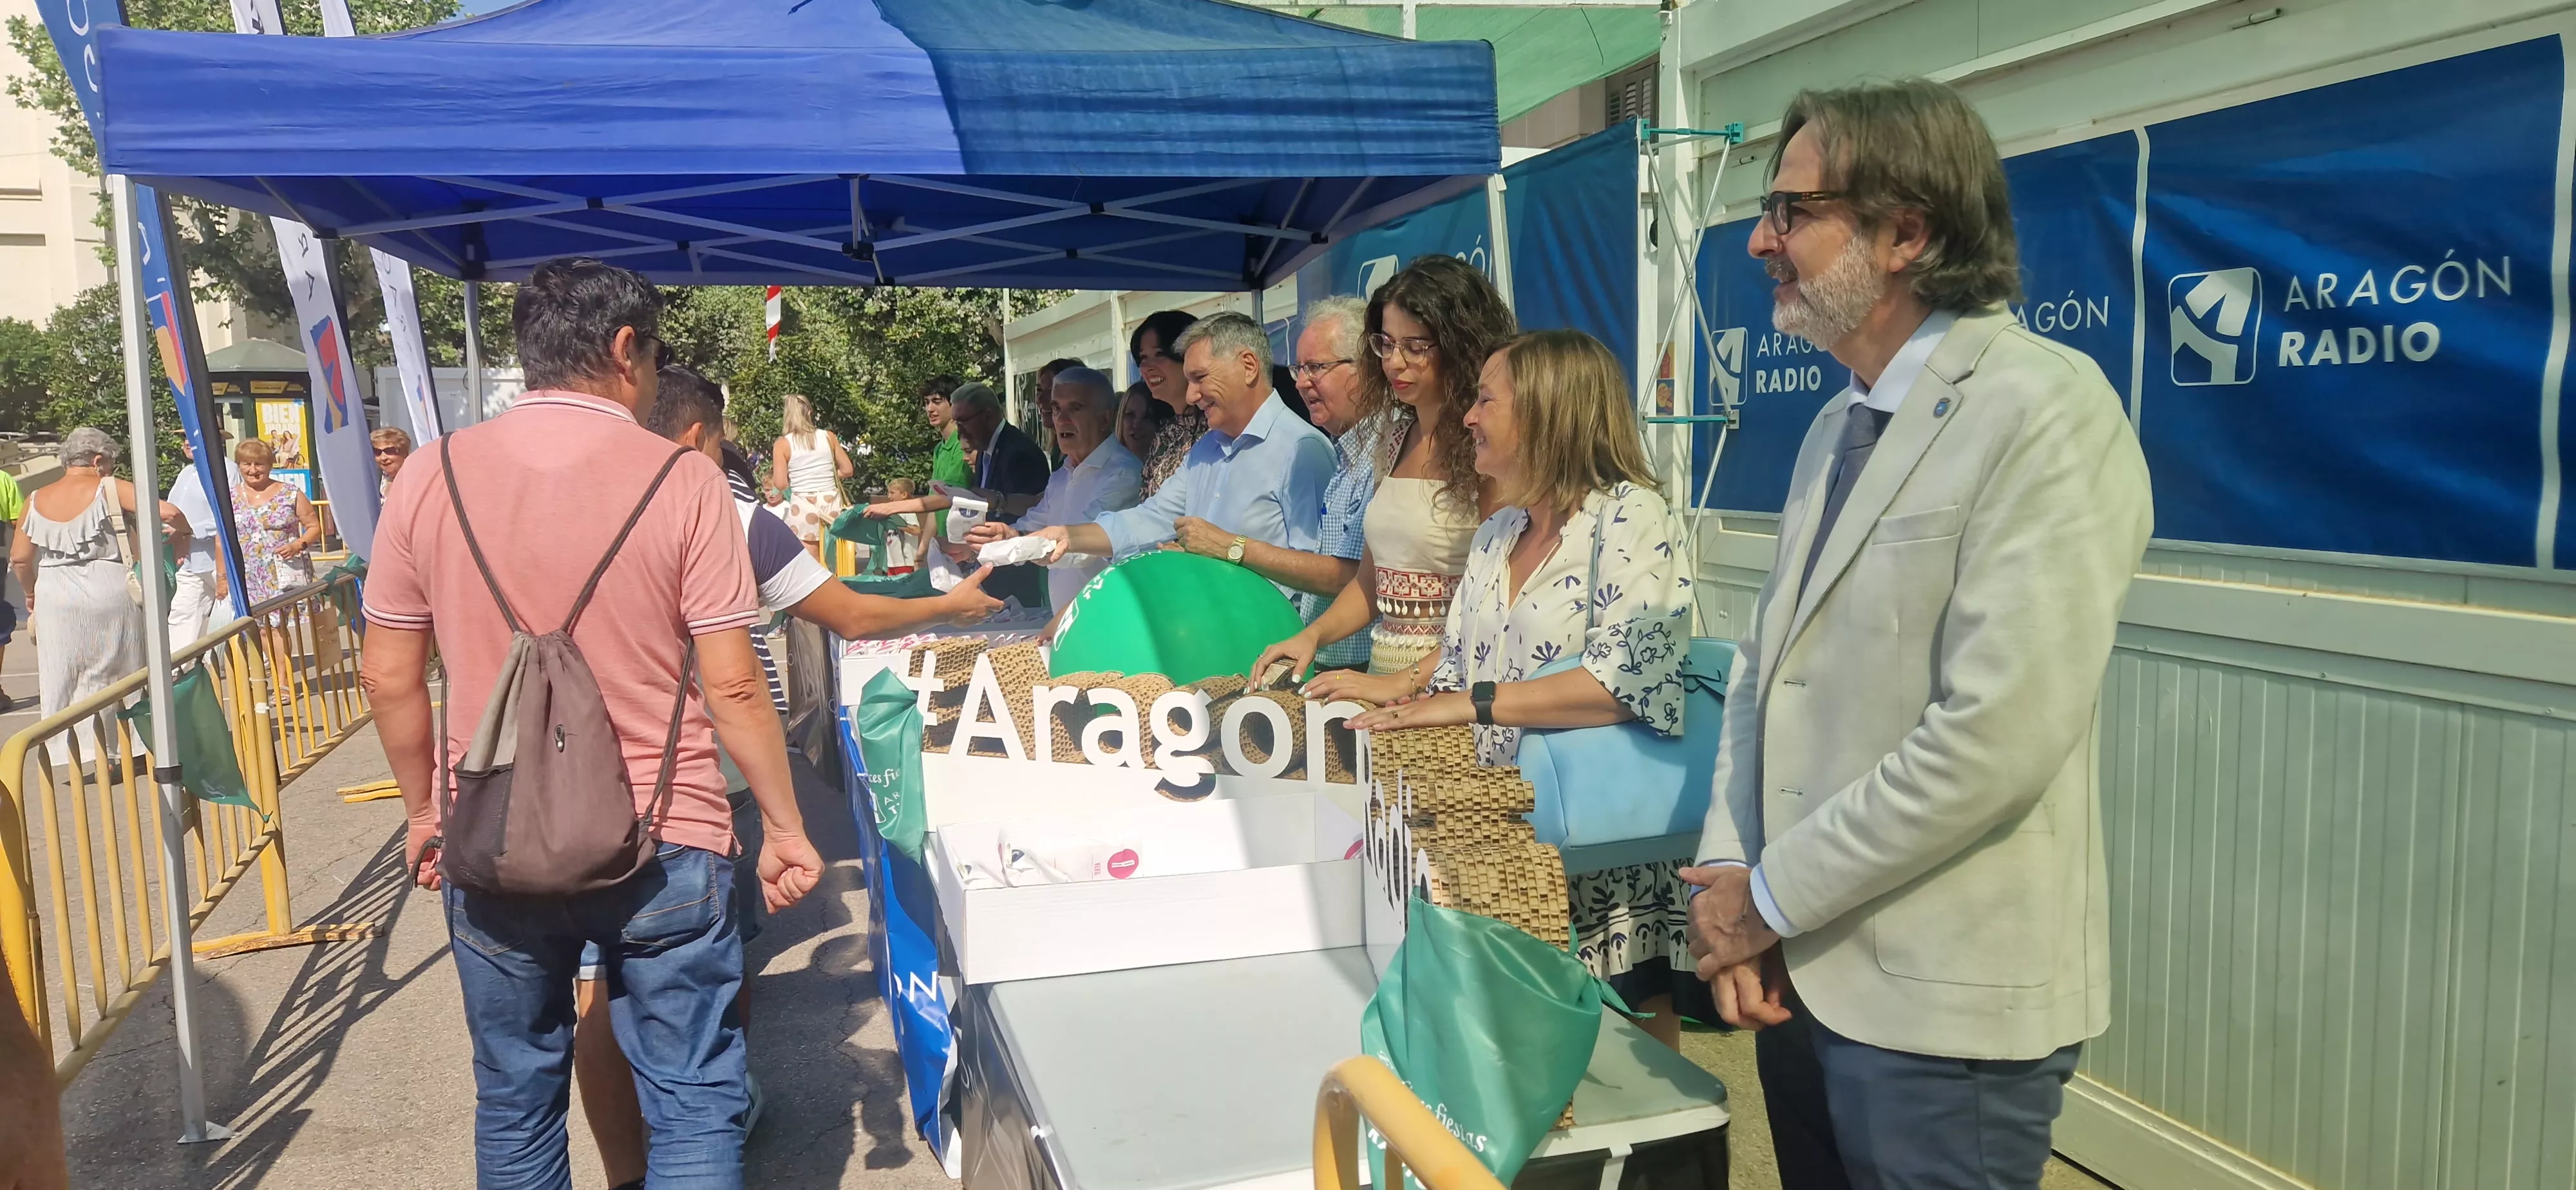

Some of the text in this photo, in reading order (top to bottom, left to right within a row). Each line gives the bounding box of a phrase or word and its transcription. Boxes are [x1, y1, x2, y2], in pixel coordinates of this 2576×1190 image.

[2284, 249, 2511, 312] ARAGÓN
[2016, 289, 2109, 333] AGÓN
[1756, 332, 1828, 358] ARAG
[2278, 321, 2441, 367] RADIO
[1756, 365, 1822, 393] RADIO
[261, 403, 300, 423] BIEN
